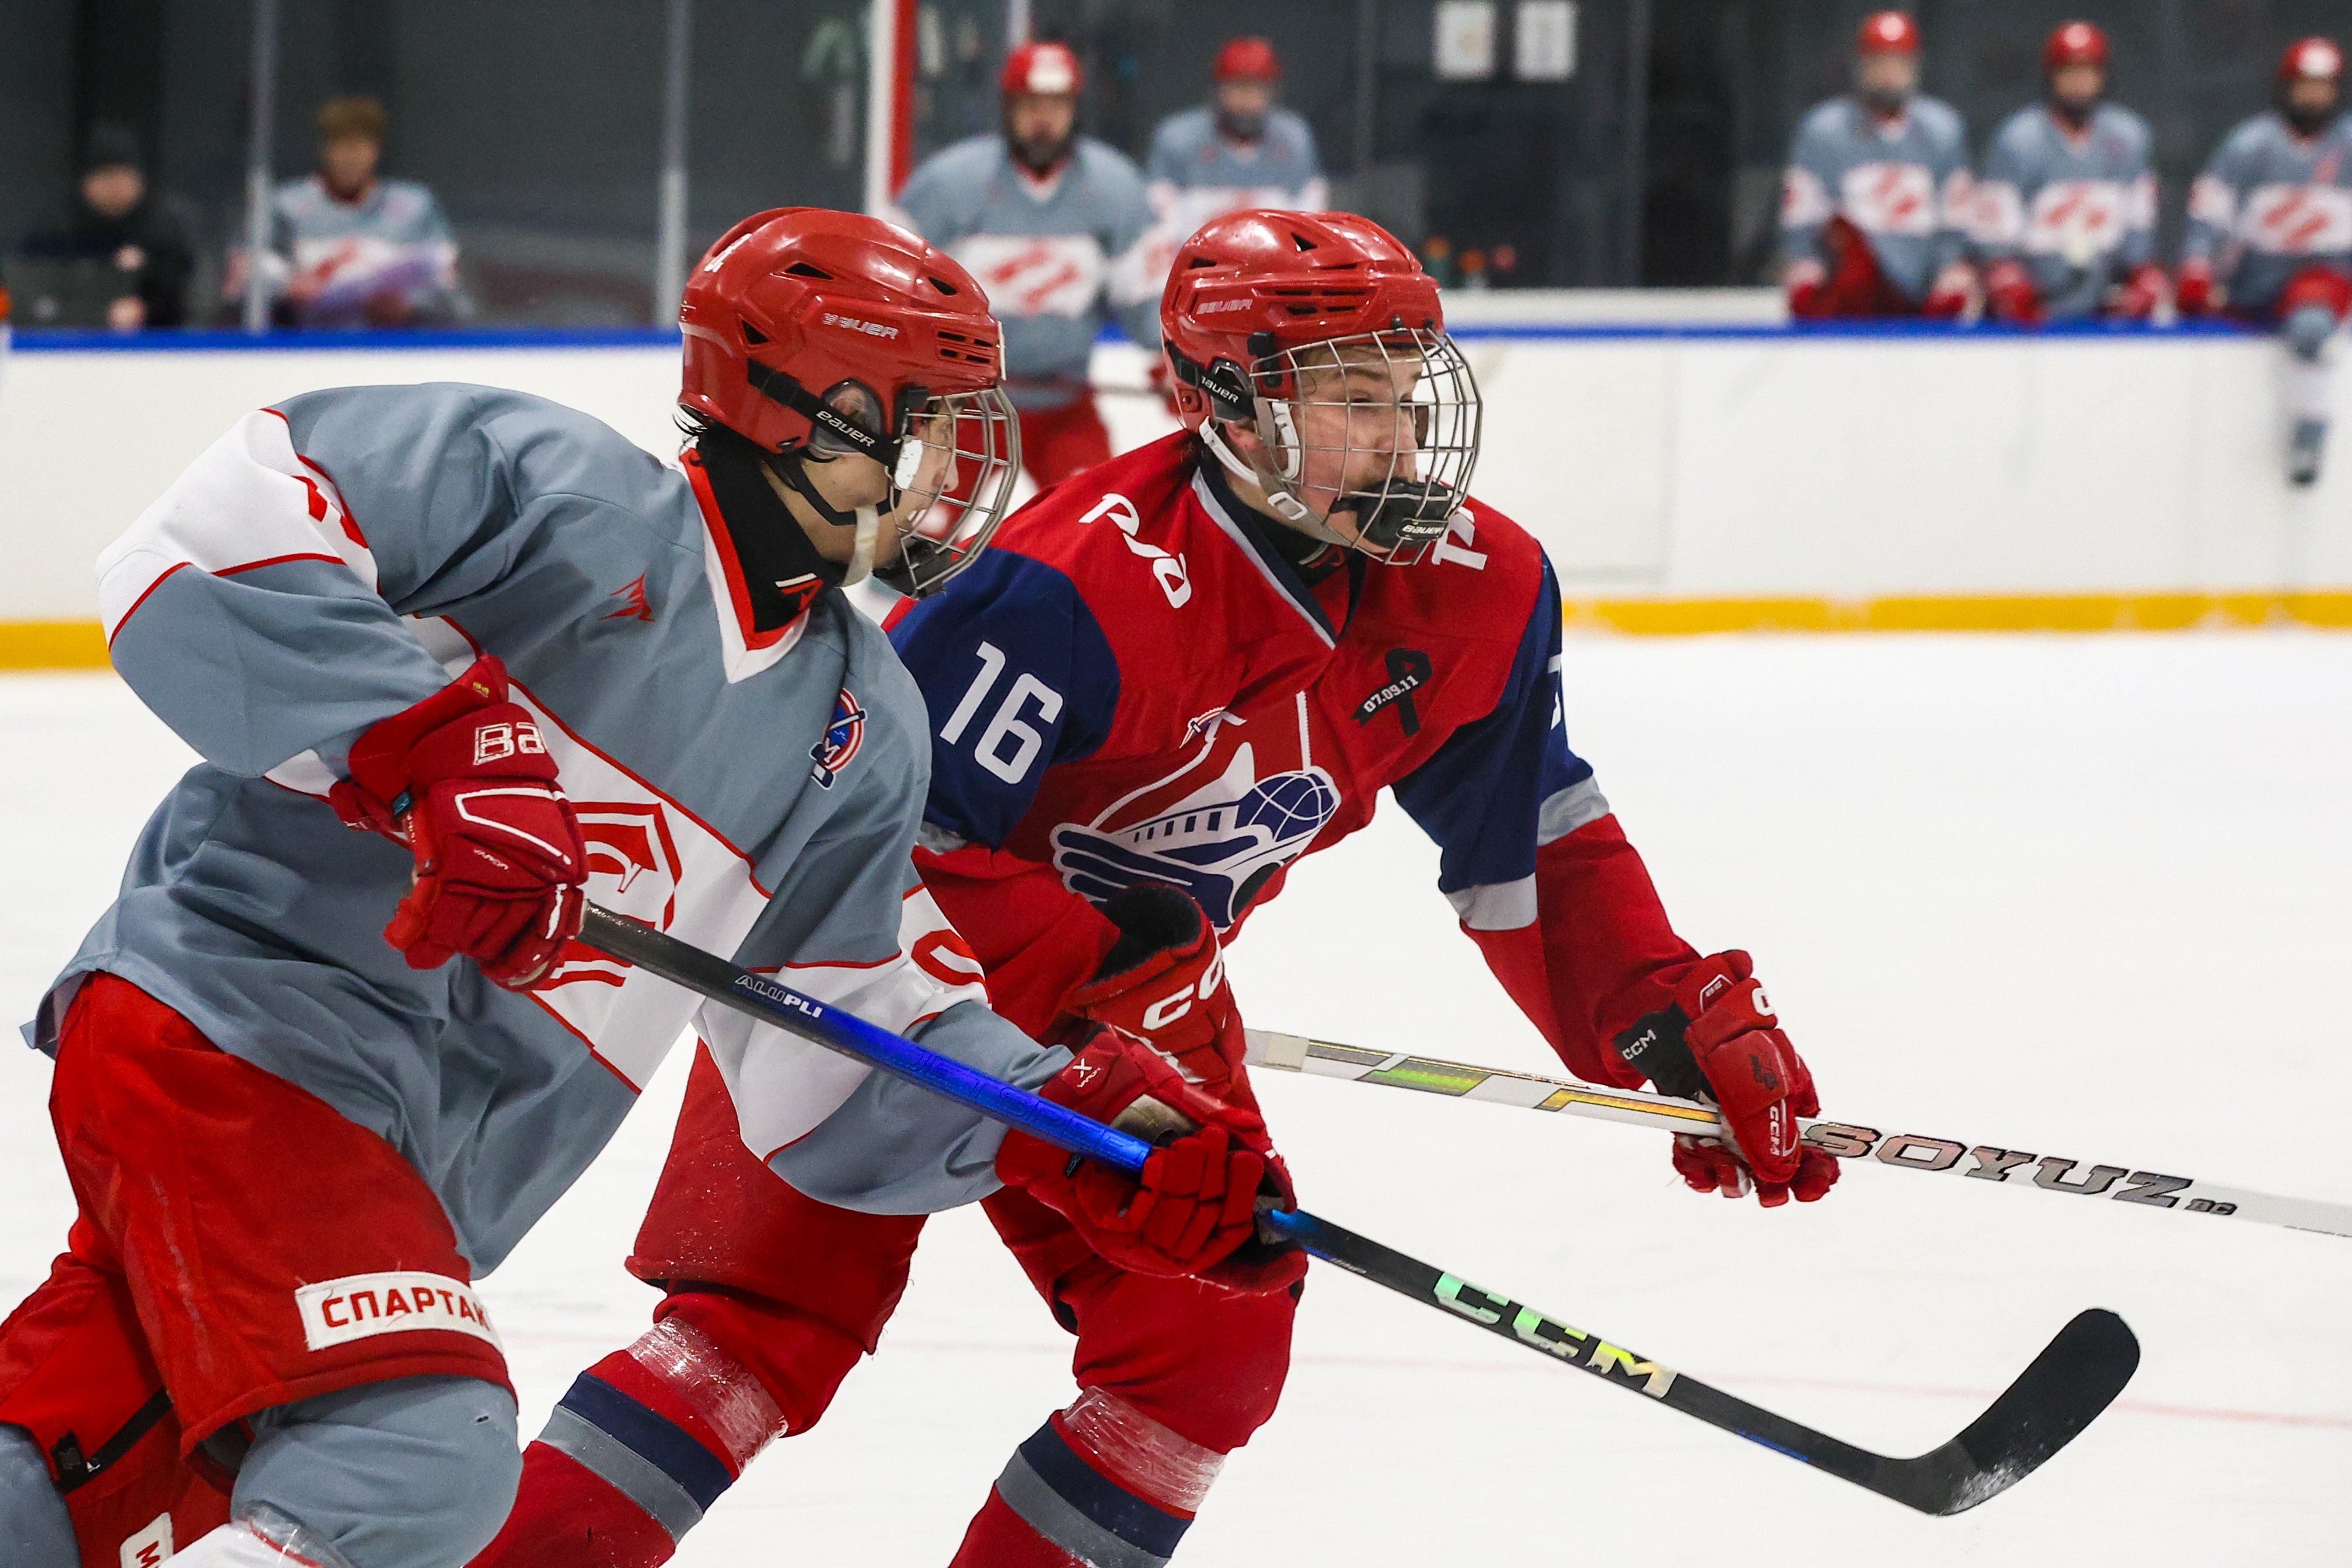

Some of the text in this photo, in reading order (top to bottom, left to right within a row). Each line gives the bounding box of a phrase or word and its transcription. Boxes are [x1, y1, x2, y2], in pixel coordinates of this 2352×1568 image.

[940, 641, 1063, 784] 16
[1363, 675, 1418, 713] 07.09.11
[734, 974, 823, 1018] ALUPLI
[1621, 1029, 1657, 1061] CCM
[1801, 1122, 2193, 1209] SOYUZ
[1432, 1272, 1678, 1399] CCM
